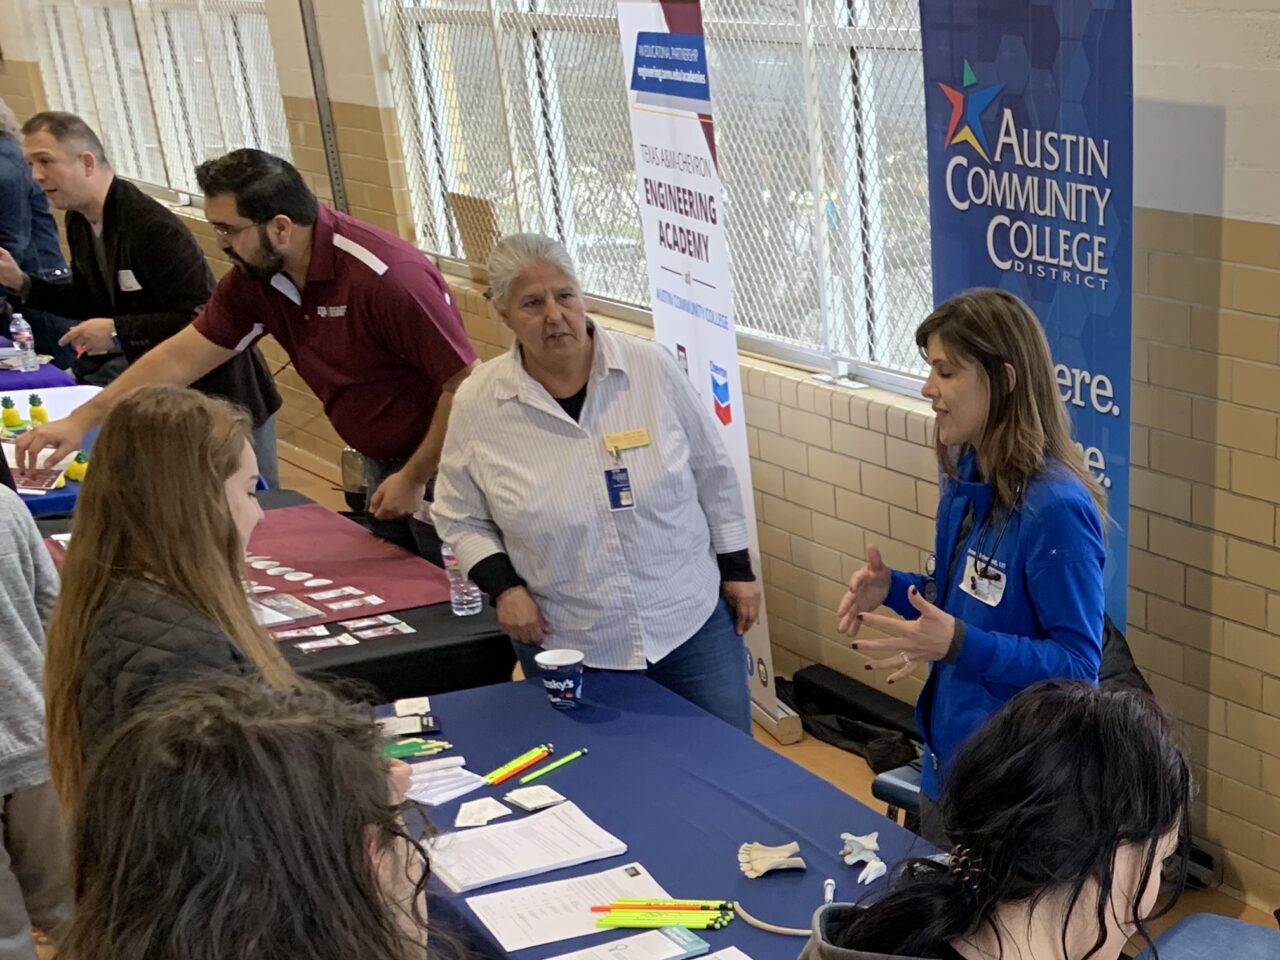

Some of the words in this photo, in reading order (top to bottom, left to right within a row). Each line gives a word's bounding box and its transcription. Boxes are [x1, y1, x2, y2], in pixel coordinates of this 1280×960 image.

[994, 108, 1110, 179] AUSTIN
[644, 178, 717, 225] ENGINEERING
[945, 155, 1111, 226] COMMUNITY
[659, 220, 709, 263] ACADEMY
[986, 214, 1109, 275] COLLEGE
[1014, 260, 1109, 290] DISTRICT
[1054, 362, 1120, 417] ere.
